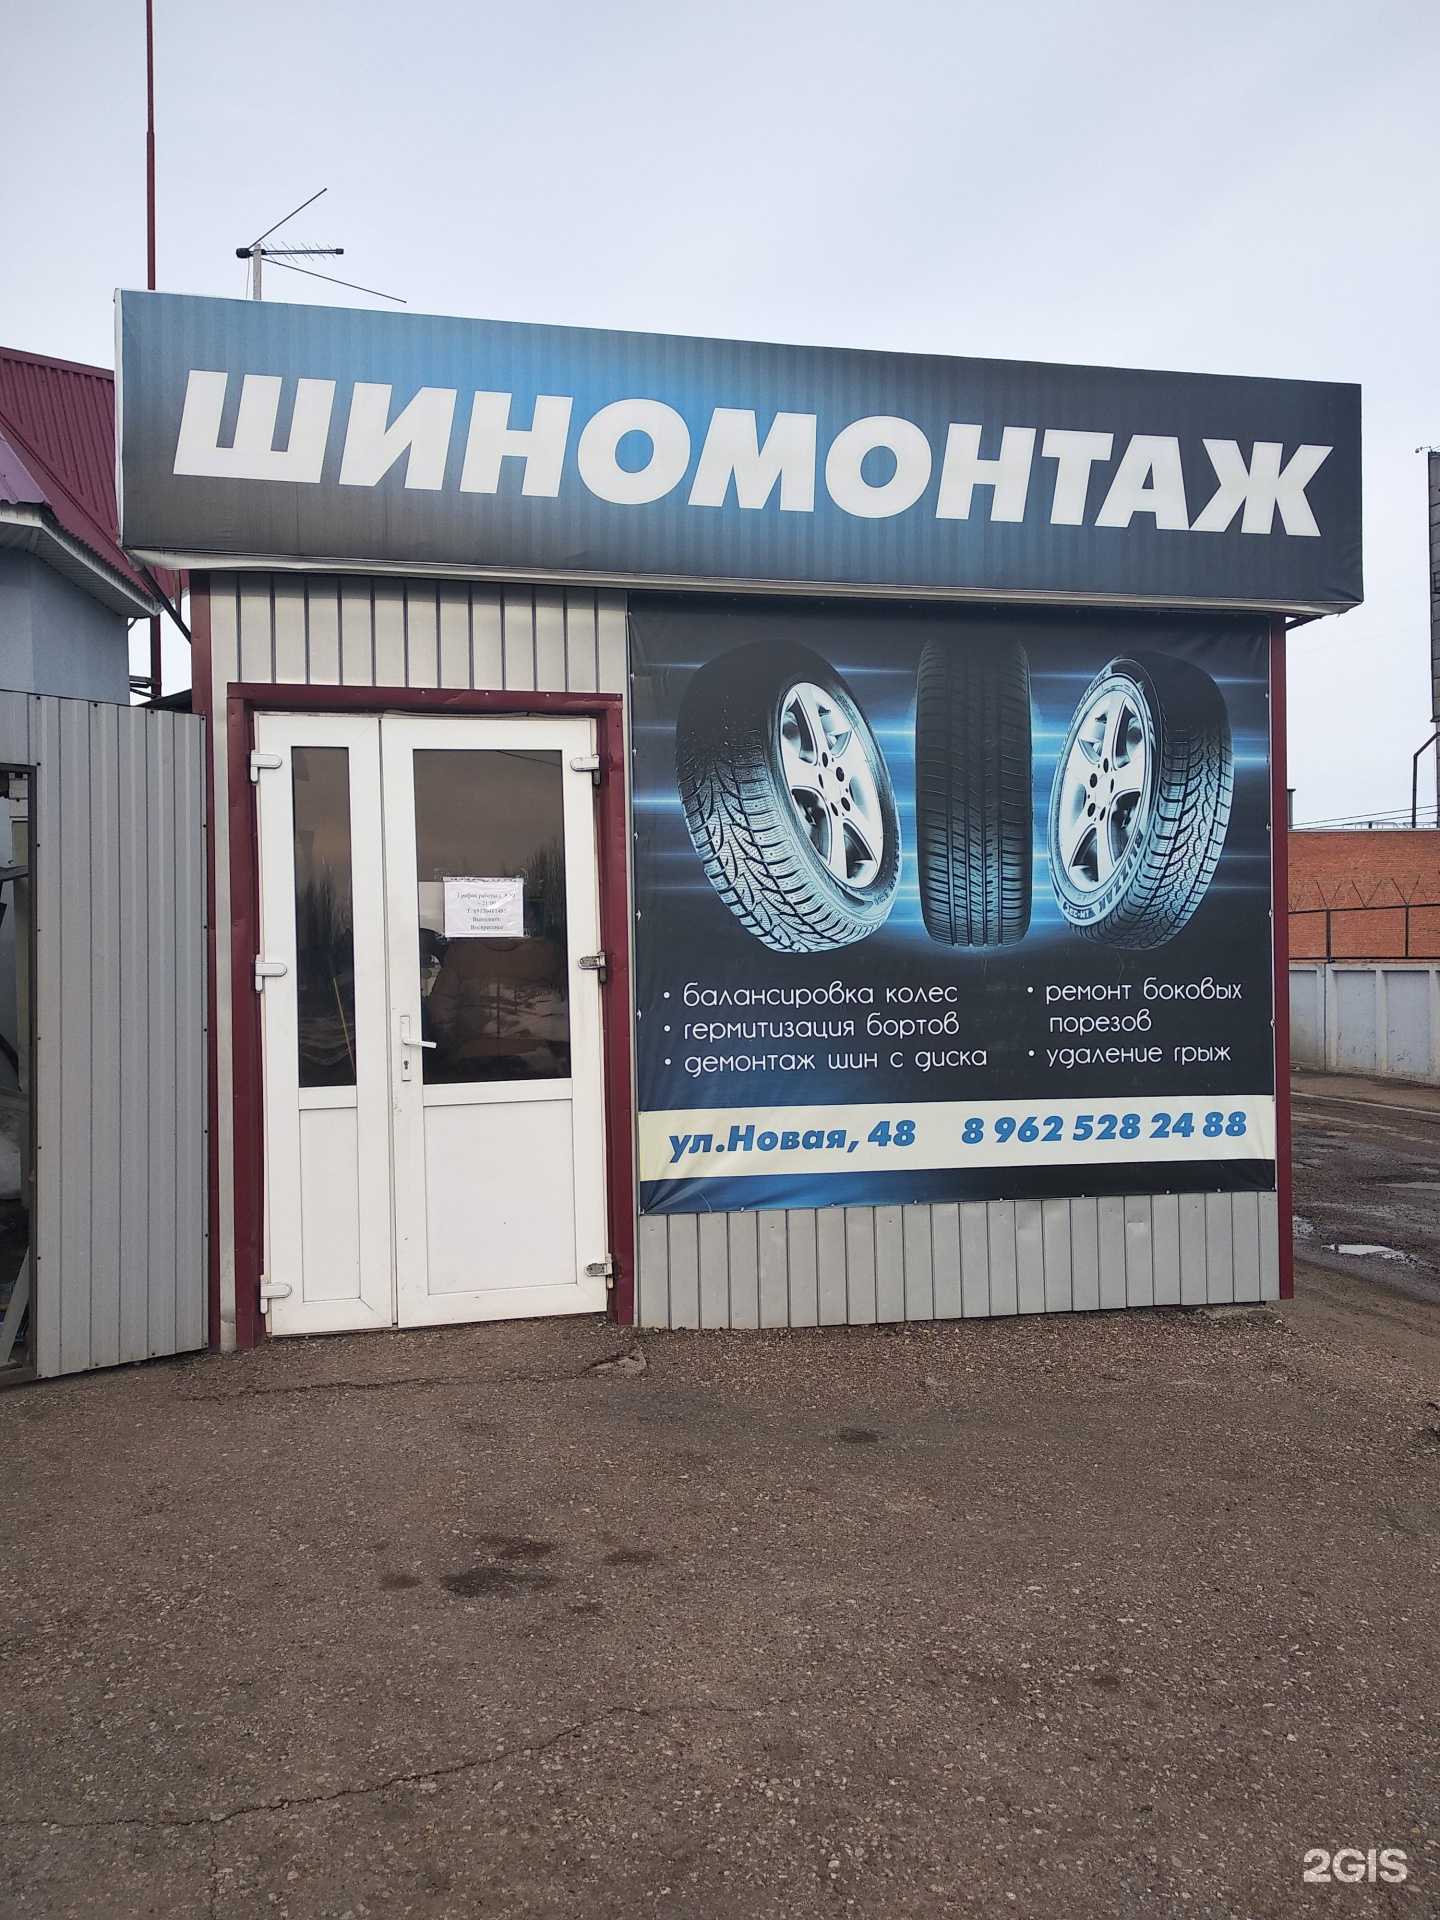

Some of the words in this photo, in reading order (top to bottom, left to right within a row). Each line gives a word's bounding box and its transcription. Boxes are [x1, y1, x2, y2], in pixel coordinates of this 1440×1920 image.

[173, 369, 1334, 537] ШИНОМОНТАЖ
[683, 980, 874, 1009] балансировка
[886, 986, 958, 1003] колес
[1046, 984, 1132, 1005] ремонт
[1143, 976, 1242, 1000] боковых
[684, 1020, 855, 1043] гермитизация
[866, 1011, 960, 1039] бортов
[1049, 1008, 1152, 1036] порезов
[684, 1054, 816, 1078] демонтаж
[828, 1052, 878, 1070] шин
[890, 1051, 904, 1068] с
[915, 1050, 987, 1072] диска
[1046, 1046, 1163, 1069] удаление
[1174, 1046, 1231, 1066] грыж
[961, 1116, 985, 1146] 8
[992, 1113, 1064, 1144] 962
[1071, 1112, 1142, 1143] 528
[1151, 1111, 1195, 1139] 24
[1201, 1110, 1248, 1138] 88
